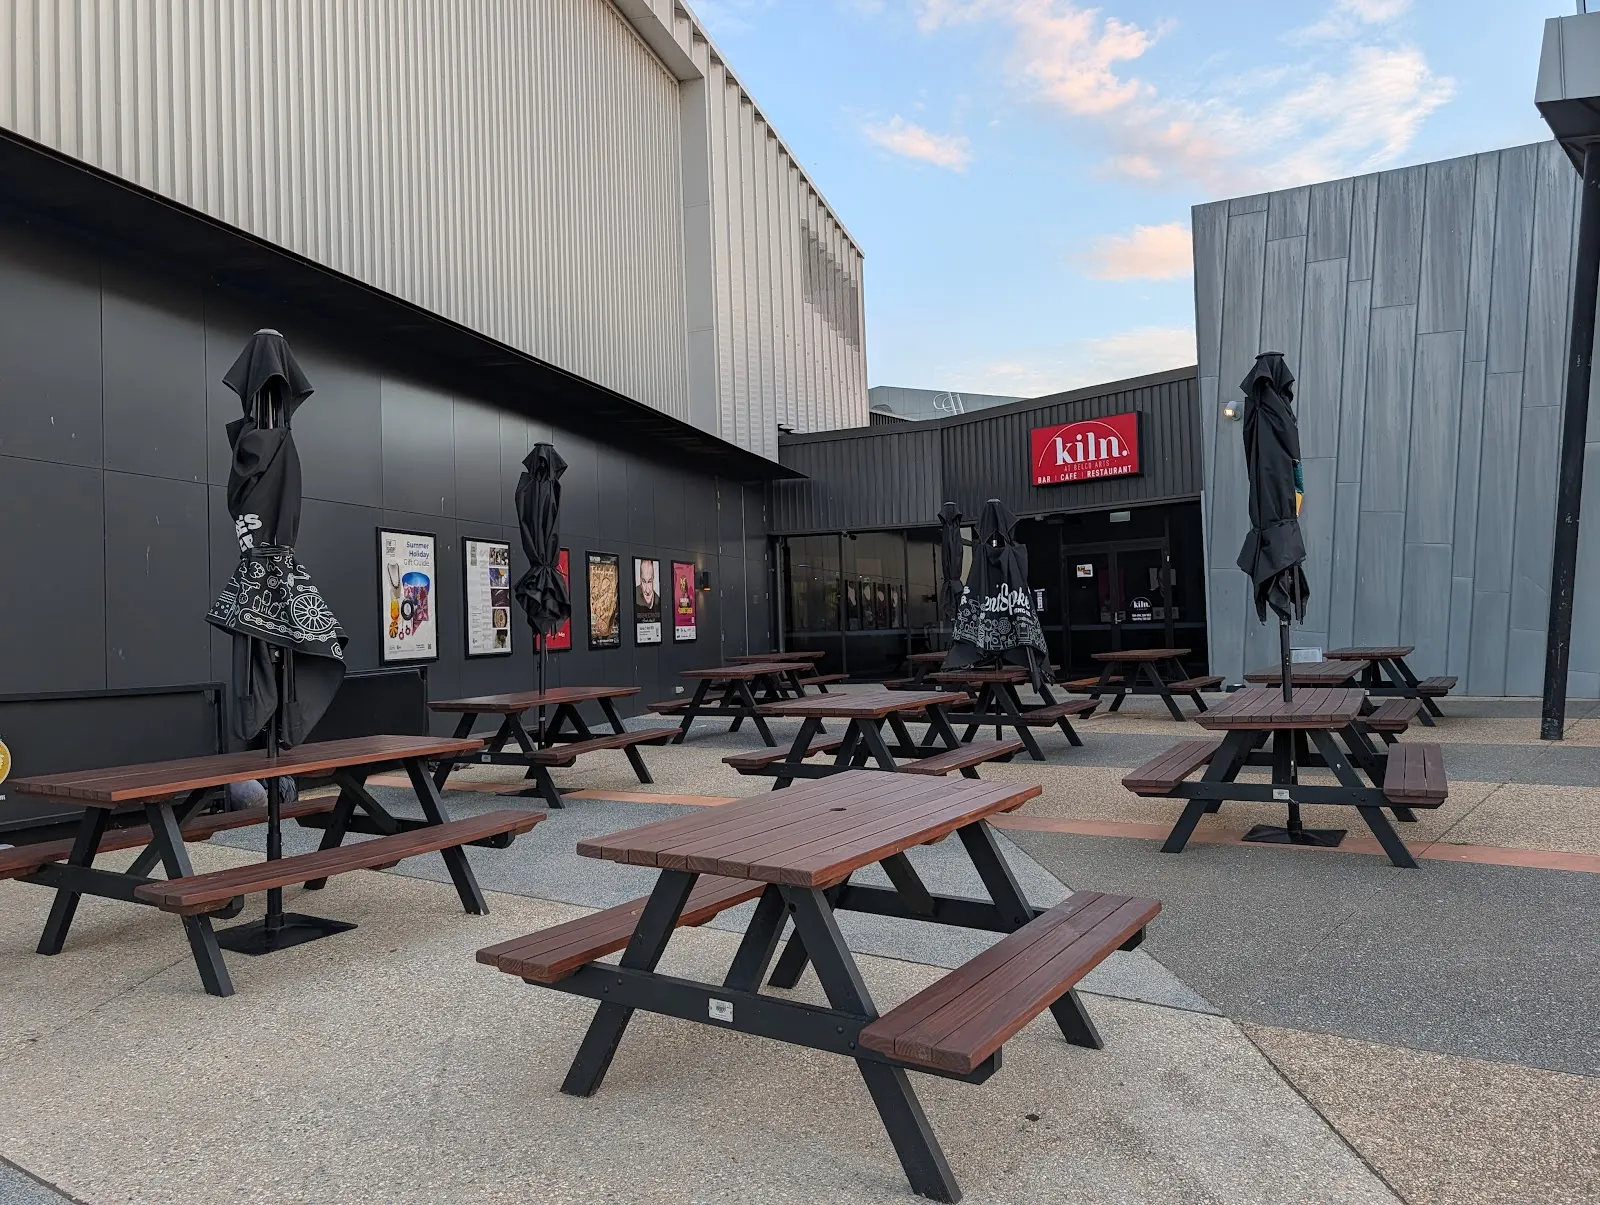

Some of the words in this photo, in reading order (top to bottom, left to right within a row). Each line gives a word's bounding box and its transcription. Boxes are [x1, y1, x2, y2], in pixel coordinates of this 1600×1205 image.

[1054, 432, 1128, 466] kiln.
[1094, 459, 1110, 469] ARTS
[1037, 475, 1051, 484] BAR
[1060, 471, 1077, 481] CAFE
[1087, 464, 1132, 478] RESTAURANT
[406, 541, 429, 550] Summer
[408, 550, 430, 560] Holiday
[403, 558, 413, 566] Gift
[413, 559, 430, 567] Guide
[480, 548, 492, 652] EXHIBITIONS
